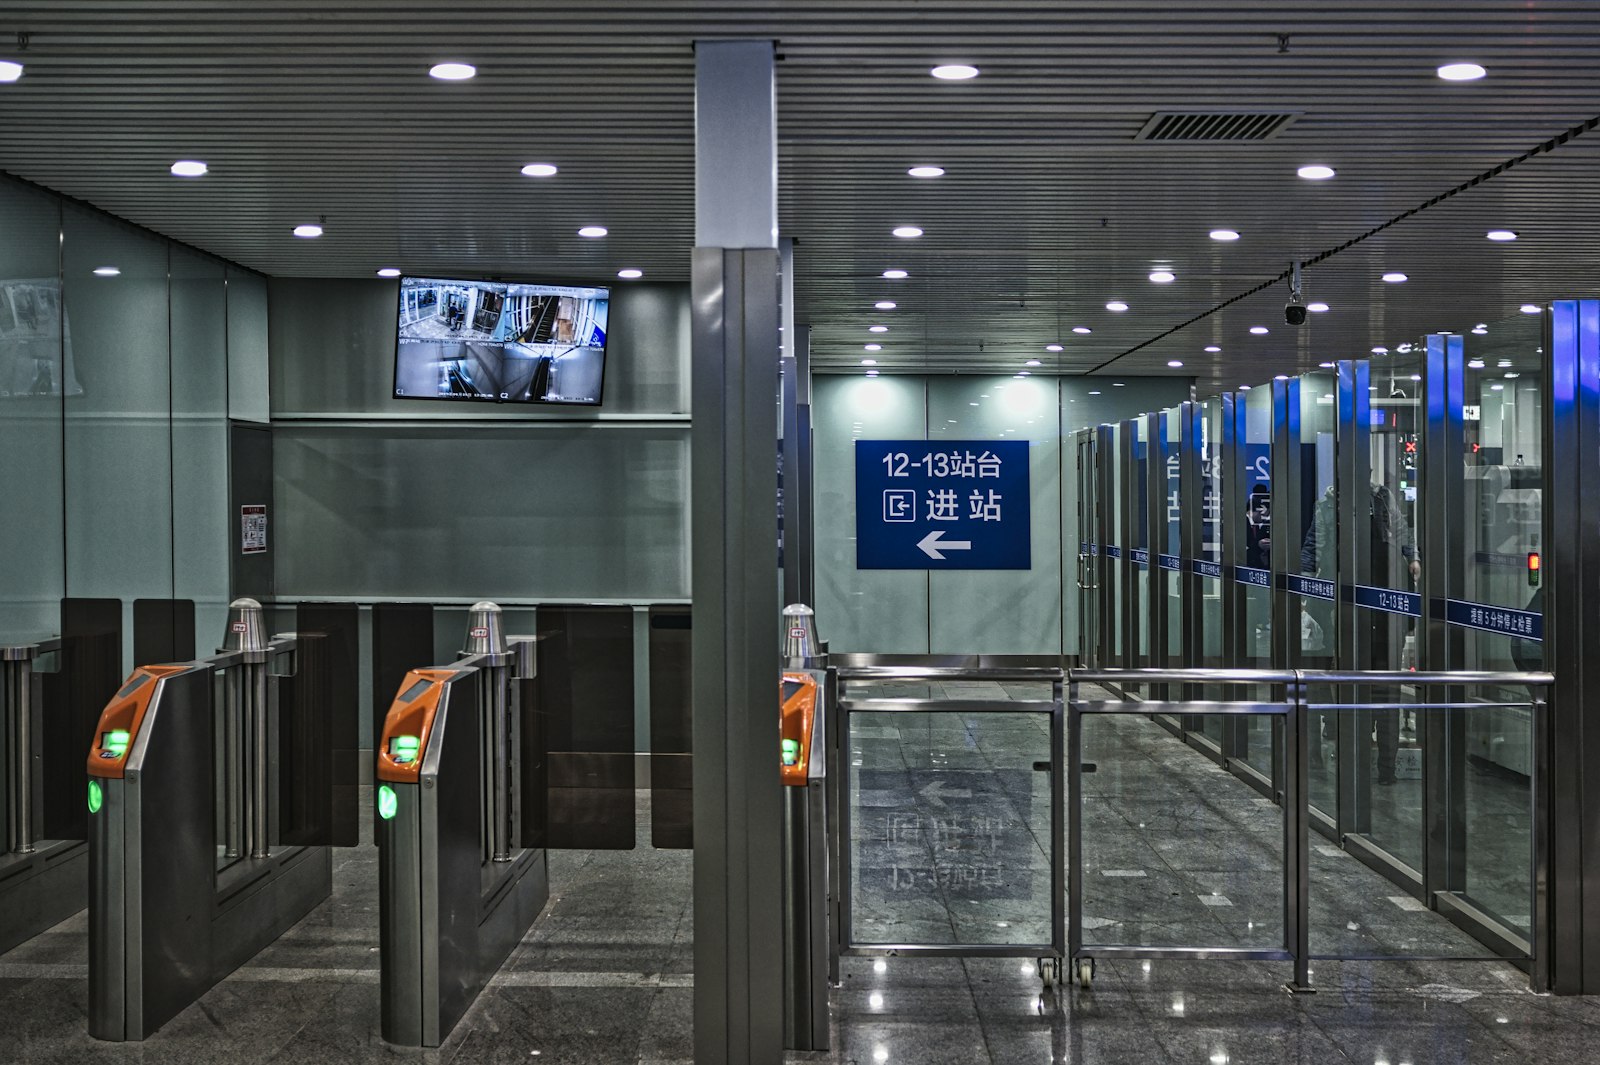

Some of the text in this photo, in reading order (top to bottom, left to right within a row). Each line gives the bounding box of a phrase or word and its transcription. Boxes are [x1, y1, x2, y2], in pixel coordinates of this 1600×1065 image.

[882, 451, 1003, 479] 12-13站台
[925, 489, 1002, 522] 进站
[1379, 592, 1410, 612] 12-13站台
